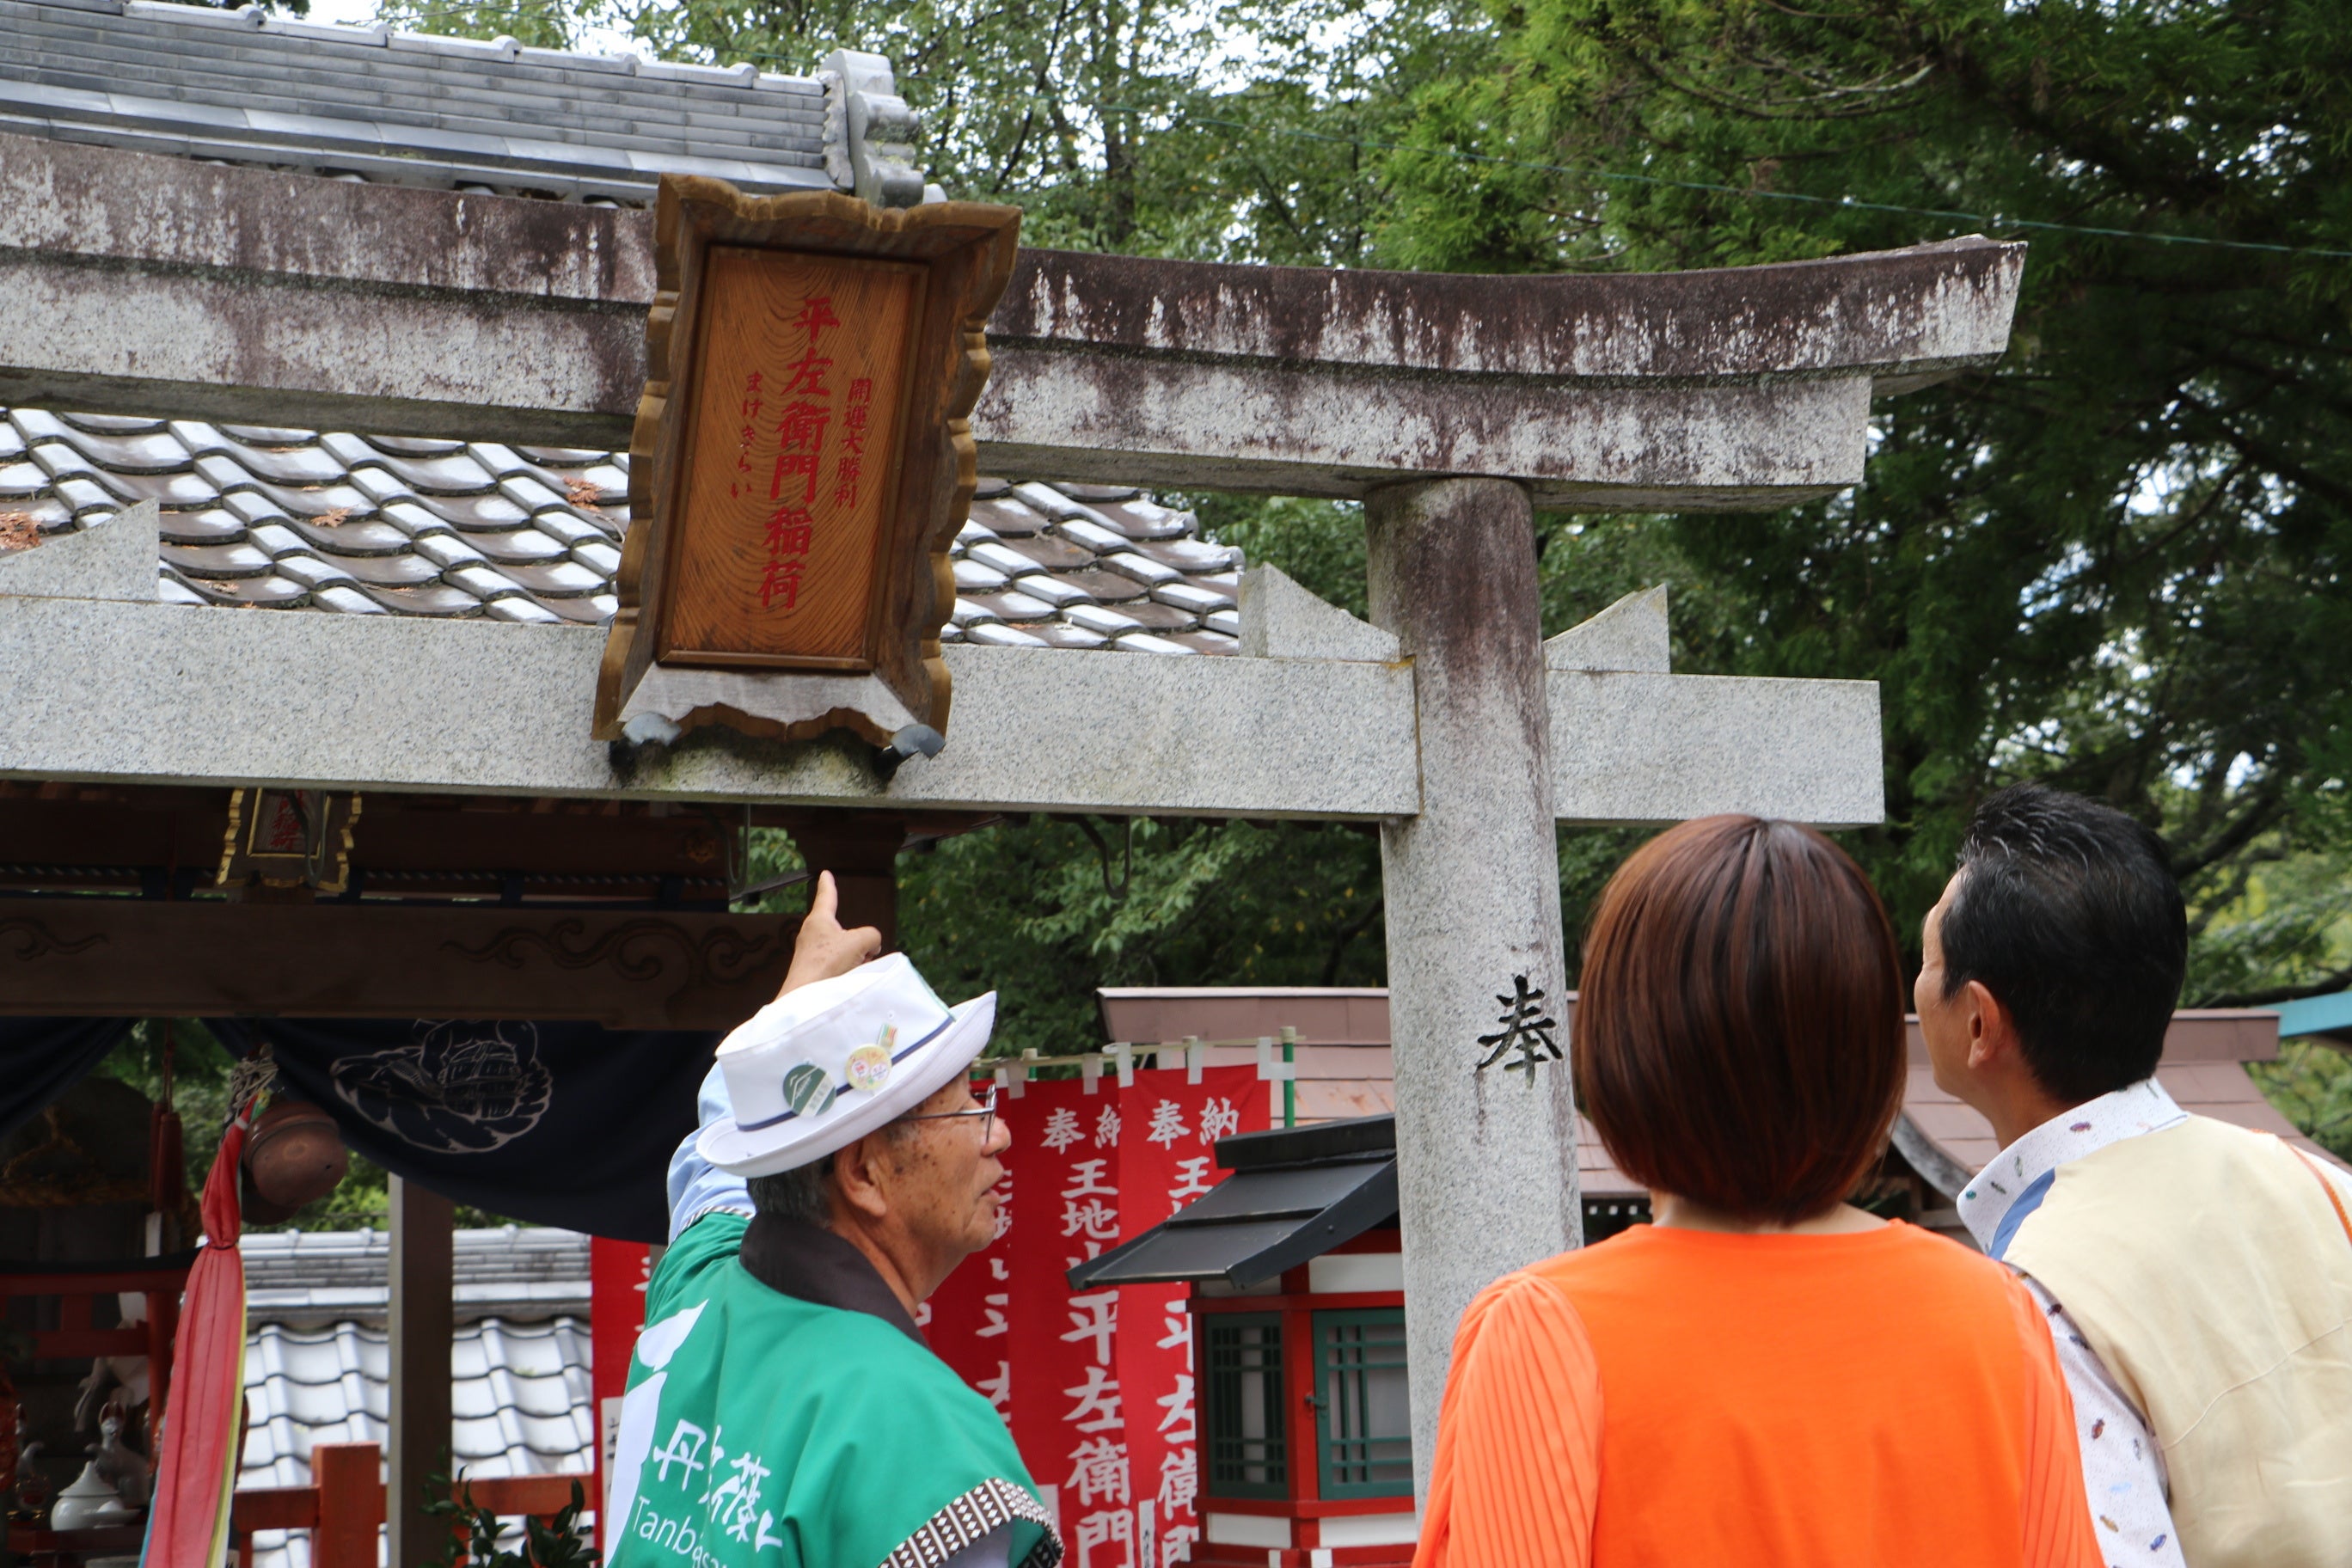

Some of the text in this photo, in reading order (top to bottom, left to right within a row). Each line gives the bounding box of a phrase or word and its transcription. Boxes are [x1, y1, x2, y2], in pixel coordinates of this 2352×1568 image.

[756, 297, 842, 609] 平左衛門稲荷
[1477, 974, 1565, 1088] 奉
[1145, 1097, 1240, 1151] 奉納
